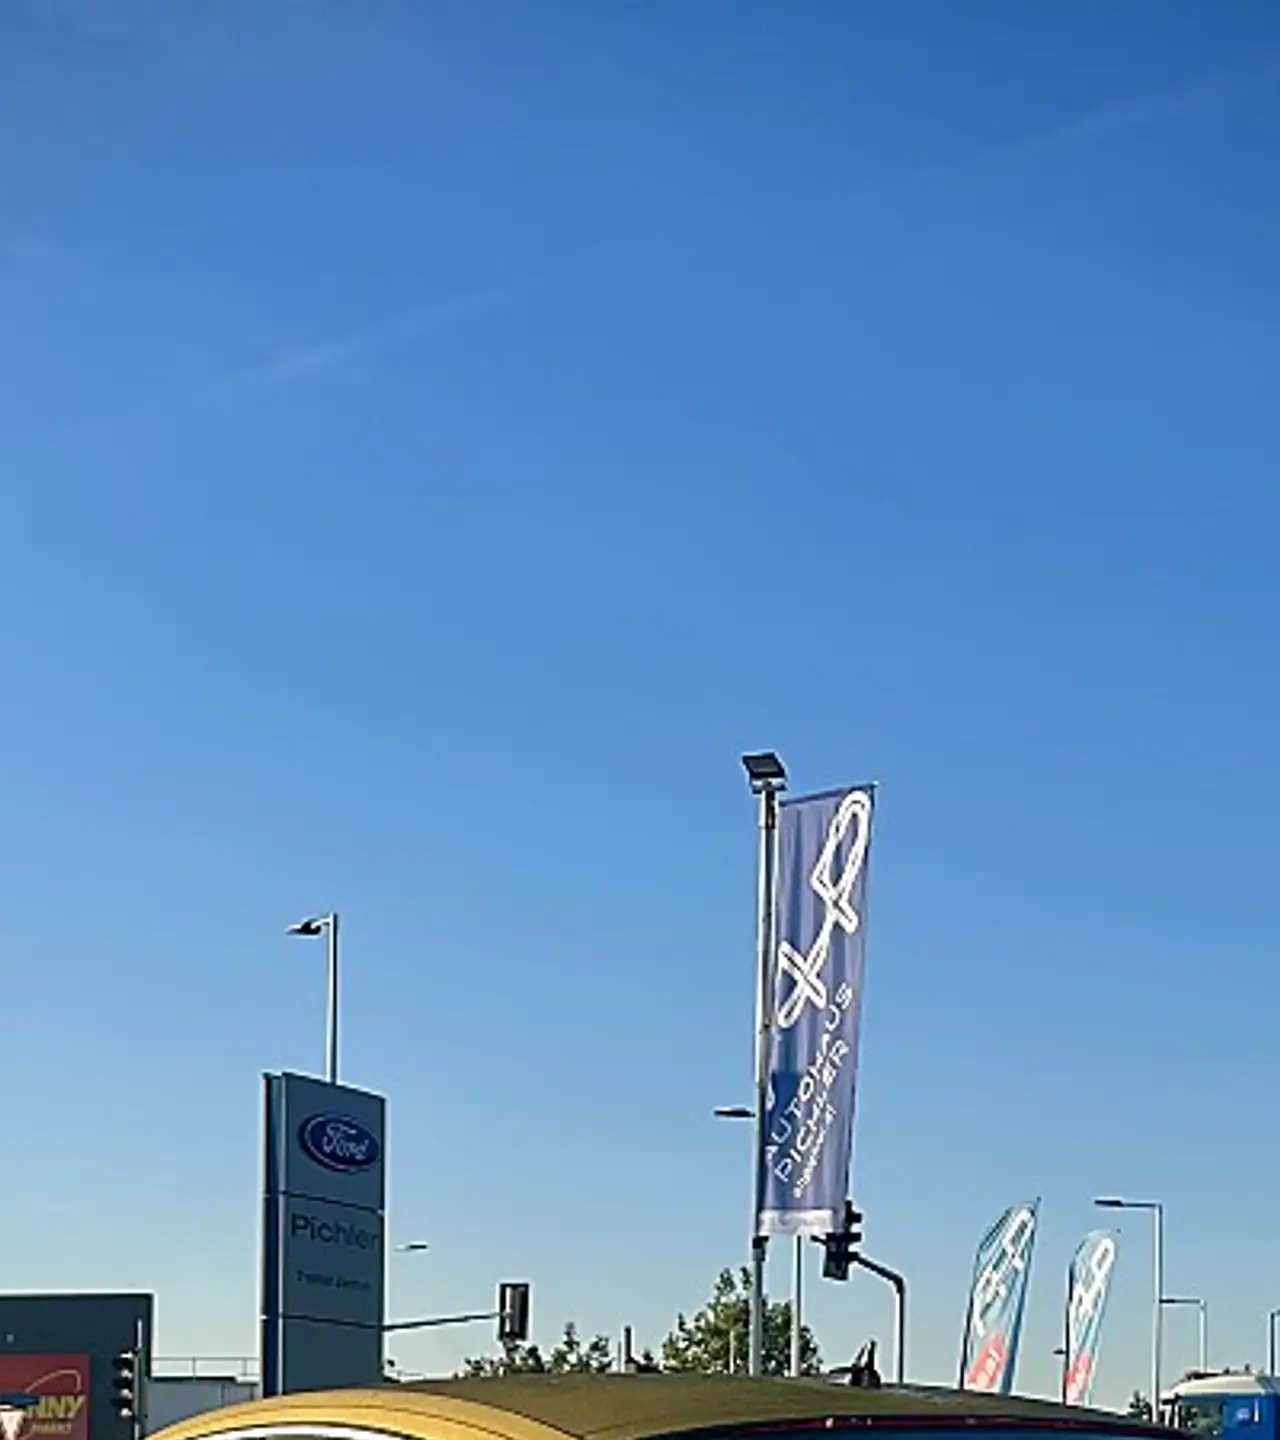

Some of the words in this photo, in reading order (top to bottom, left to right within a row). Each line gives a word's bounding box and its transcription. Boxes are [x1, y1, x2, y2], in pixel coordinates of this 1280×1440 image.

[766, 982, 853, 1166] AUTOHAUS
[774, 1039, 849, 1183] PICHLER
[322, 1121, 370, 1161] Ford
[290, 1212, 380, 1249] Pichler
